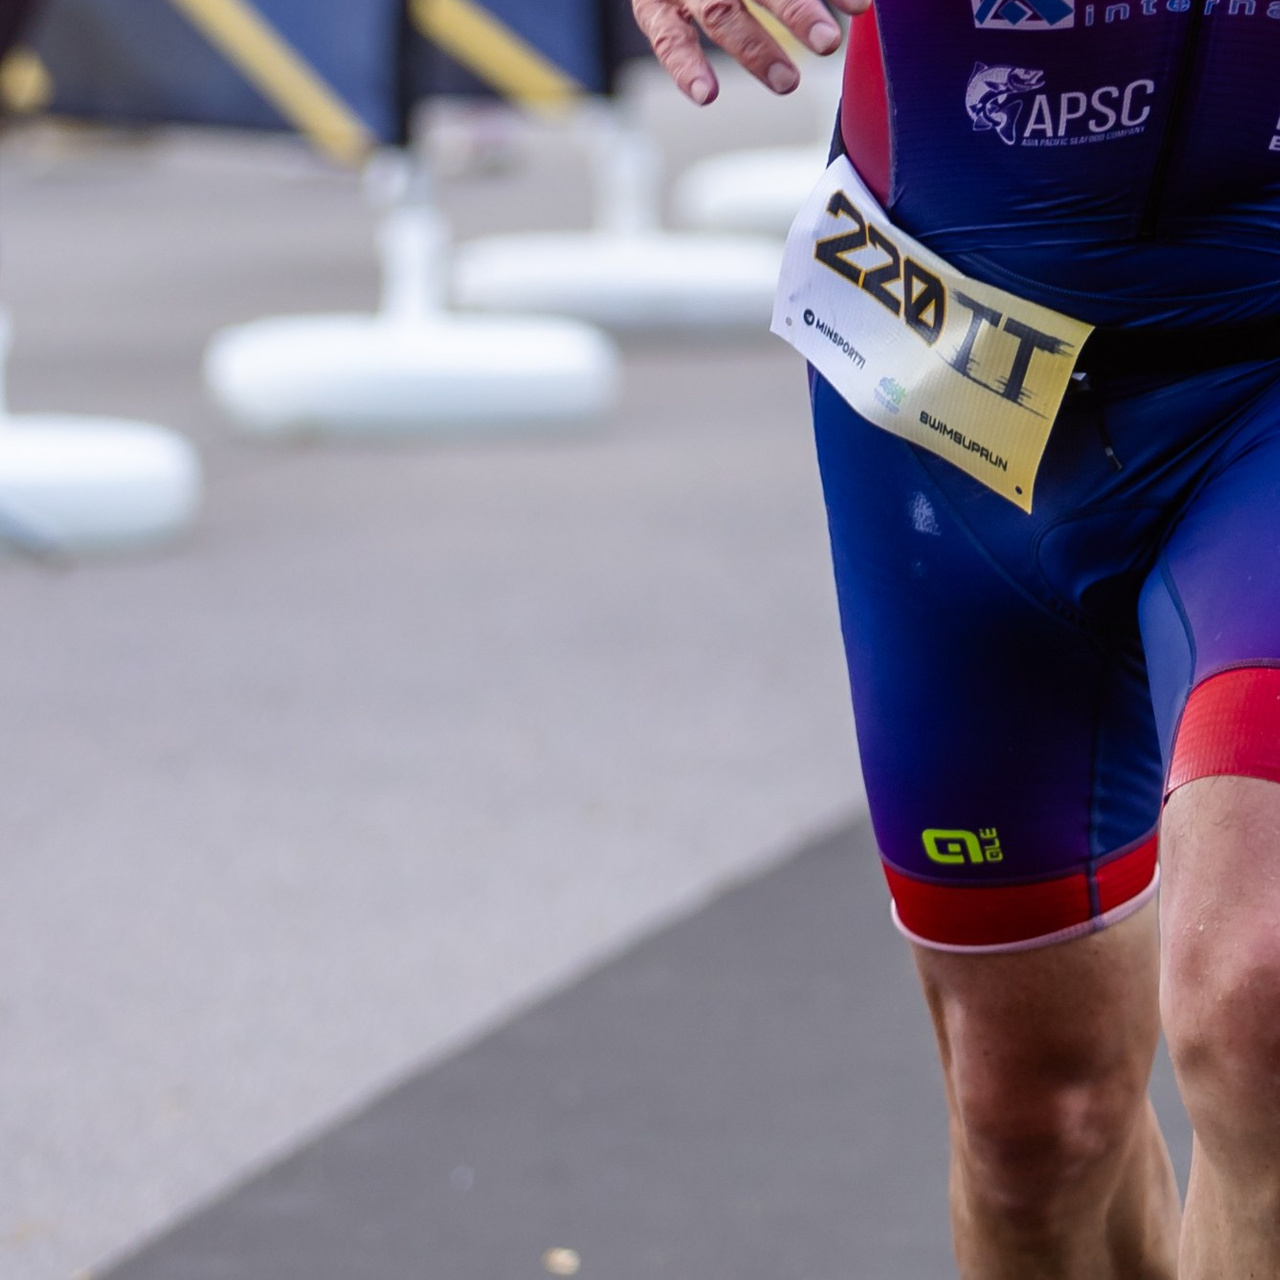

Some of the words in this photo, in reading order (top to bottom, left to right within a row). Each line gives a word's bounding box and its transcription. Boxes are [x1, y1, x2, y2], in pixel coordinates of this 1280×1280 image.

[1021, 137, 1038, 147] ASIA
[1039, 137, 1069, 147] PACIFIC
[1070, 132, 1104, 146] SEAFOOD
[1105, 125, 1145, 140] COMPANY
[1023, 79, 1155, 138] APSC
[814, 188, 947, 348] 220
[919, 410, 1008, 472] SWIMSUPRUN
